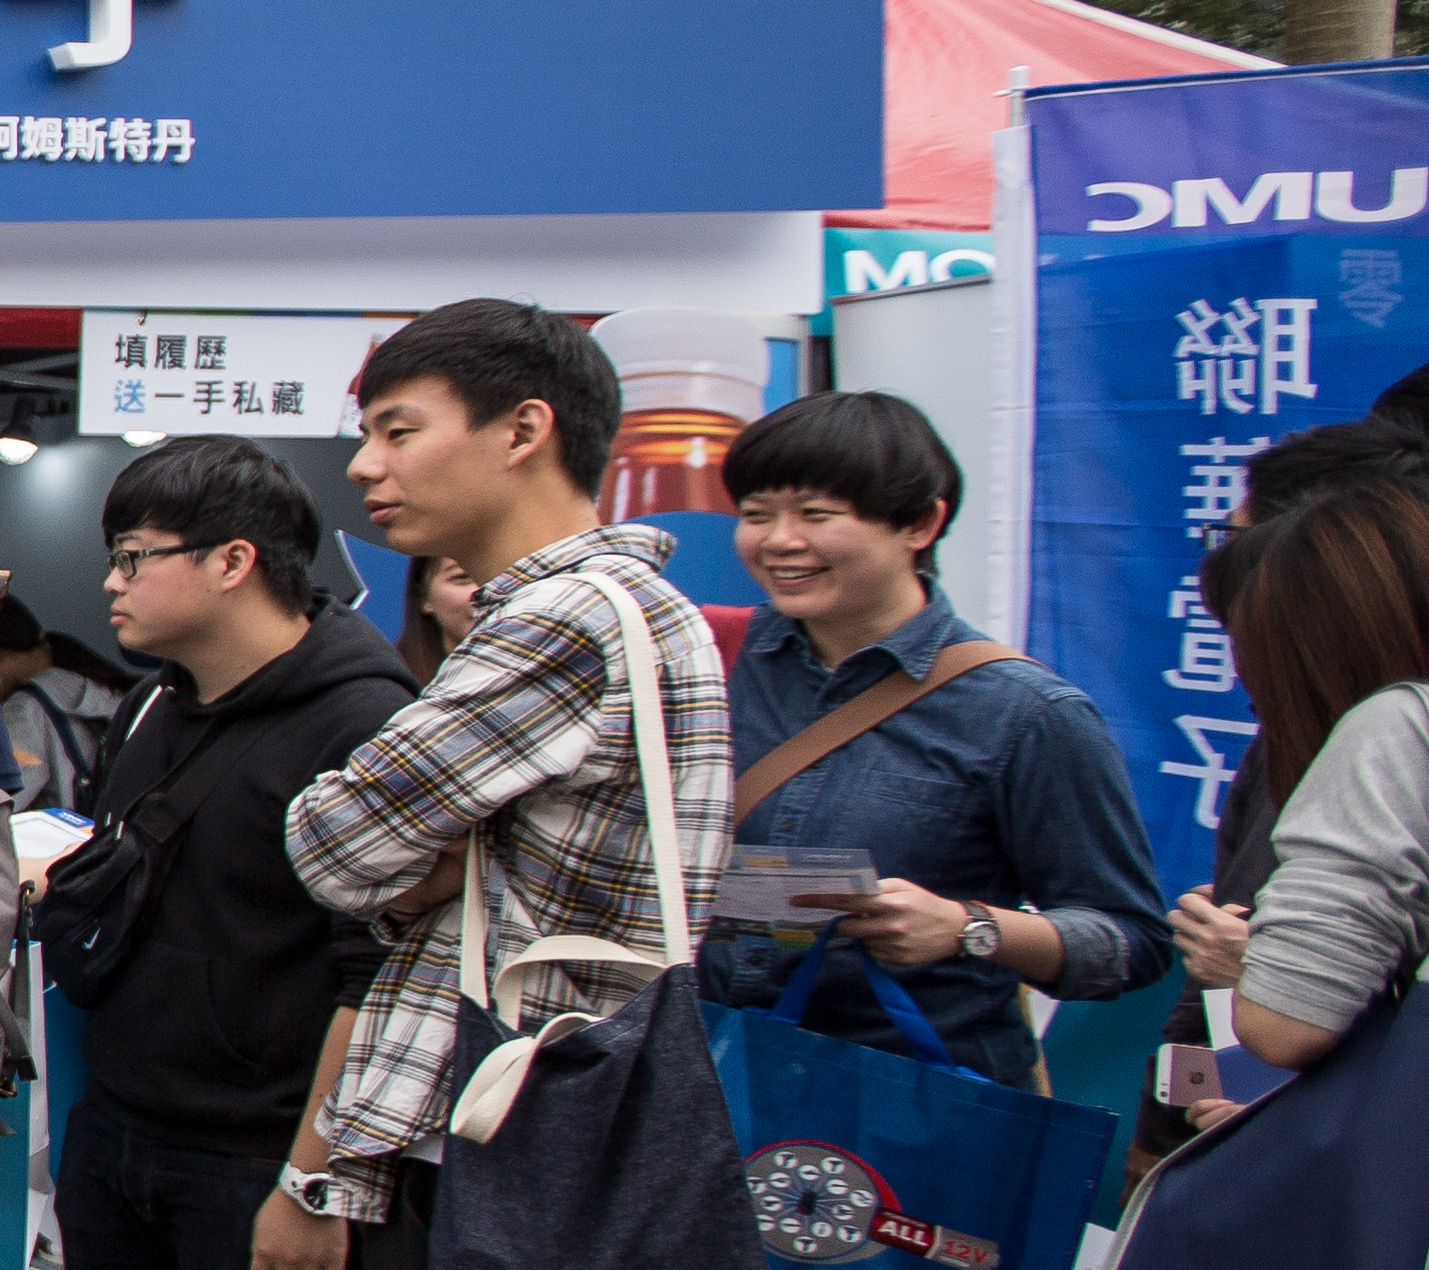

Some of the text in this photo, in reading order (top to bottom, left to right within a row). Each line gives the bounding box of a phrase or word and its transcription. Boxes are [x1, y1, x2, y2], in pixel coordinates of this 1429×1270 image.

[114, 334, 227, 370] 填履歷
[114, 379, 305, 416] 送一手私藏
[877, 1220, 929, 1247] ALL
[943, 1240, 992, 1264] 12V
